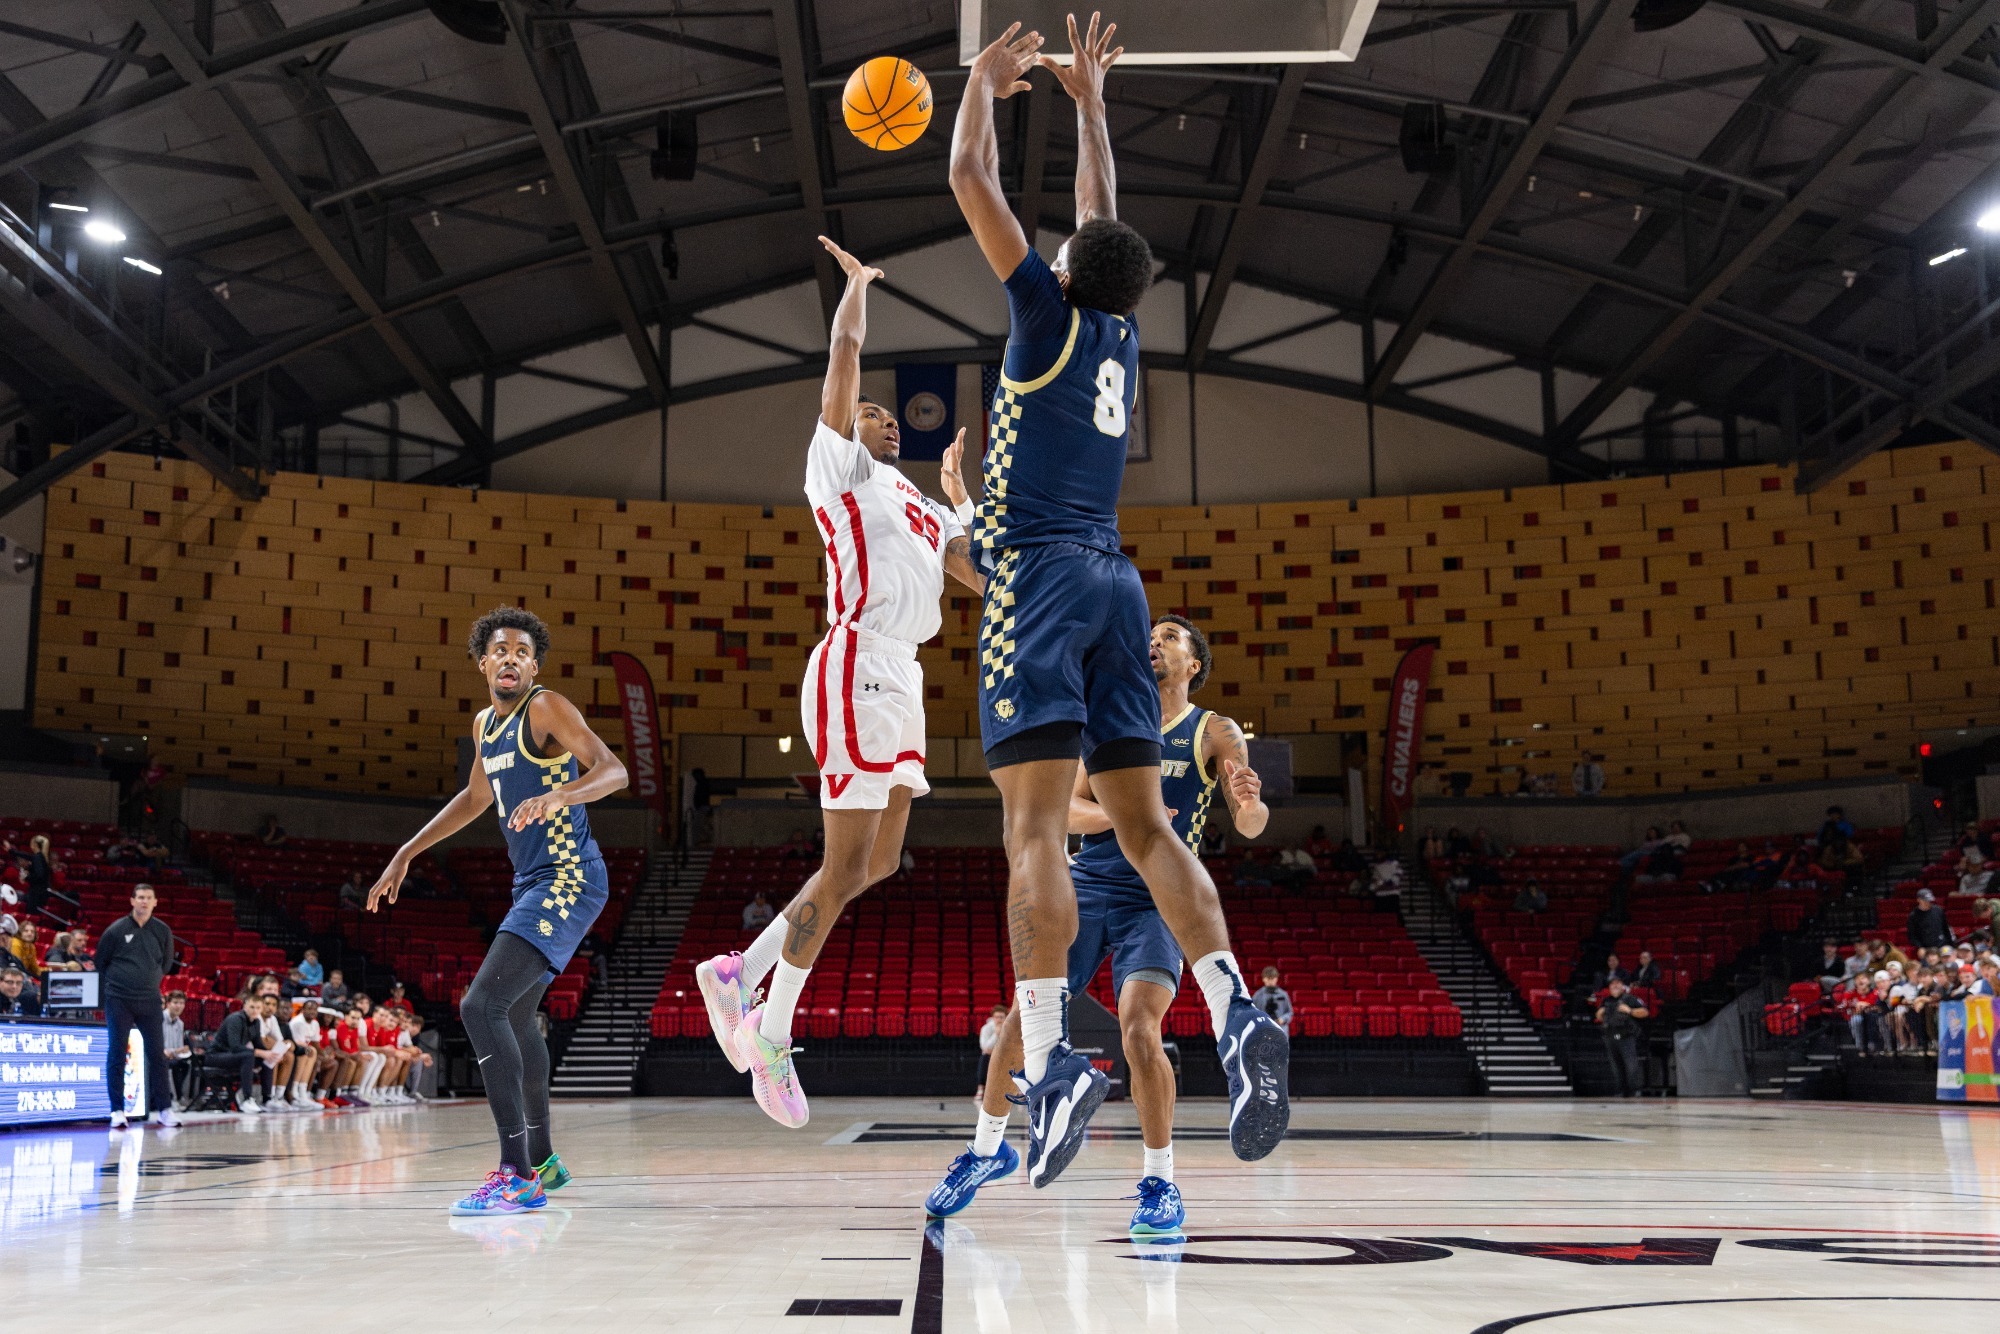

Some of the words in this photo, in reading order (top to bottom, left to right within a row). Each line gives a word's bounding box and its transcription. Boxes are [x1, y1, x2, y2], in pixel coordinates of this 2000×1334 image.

[1093, 358, 1126, 438] 8
[624, 683, 657, 796] UVAWISE
[1172, 738, 1190, 747] SAC
[1391, 677, 1420, 798] CAVALIERS
[825, 774, 855, 799] V
[2, 1062, 18, 1083] the
[19, 1062, 60, 1082] schedule
[61, 1062, 77, 1081] and
[78, 1066, 100, 1081] menu
